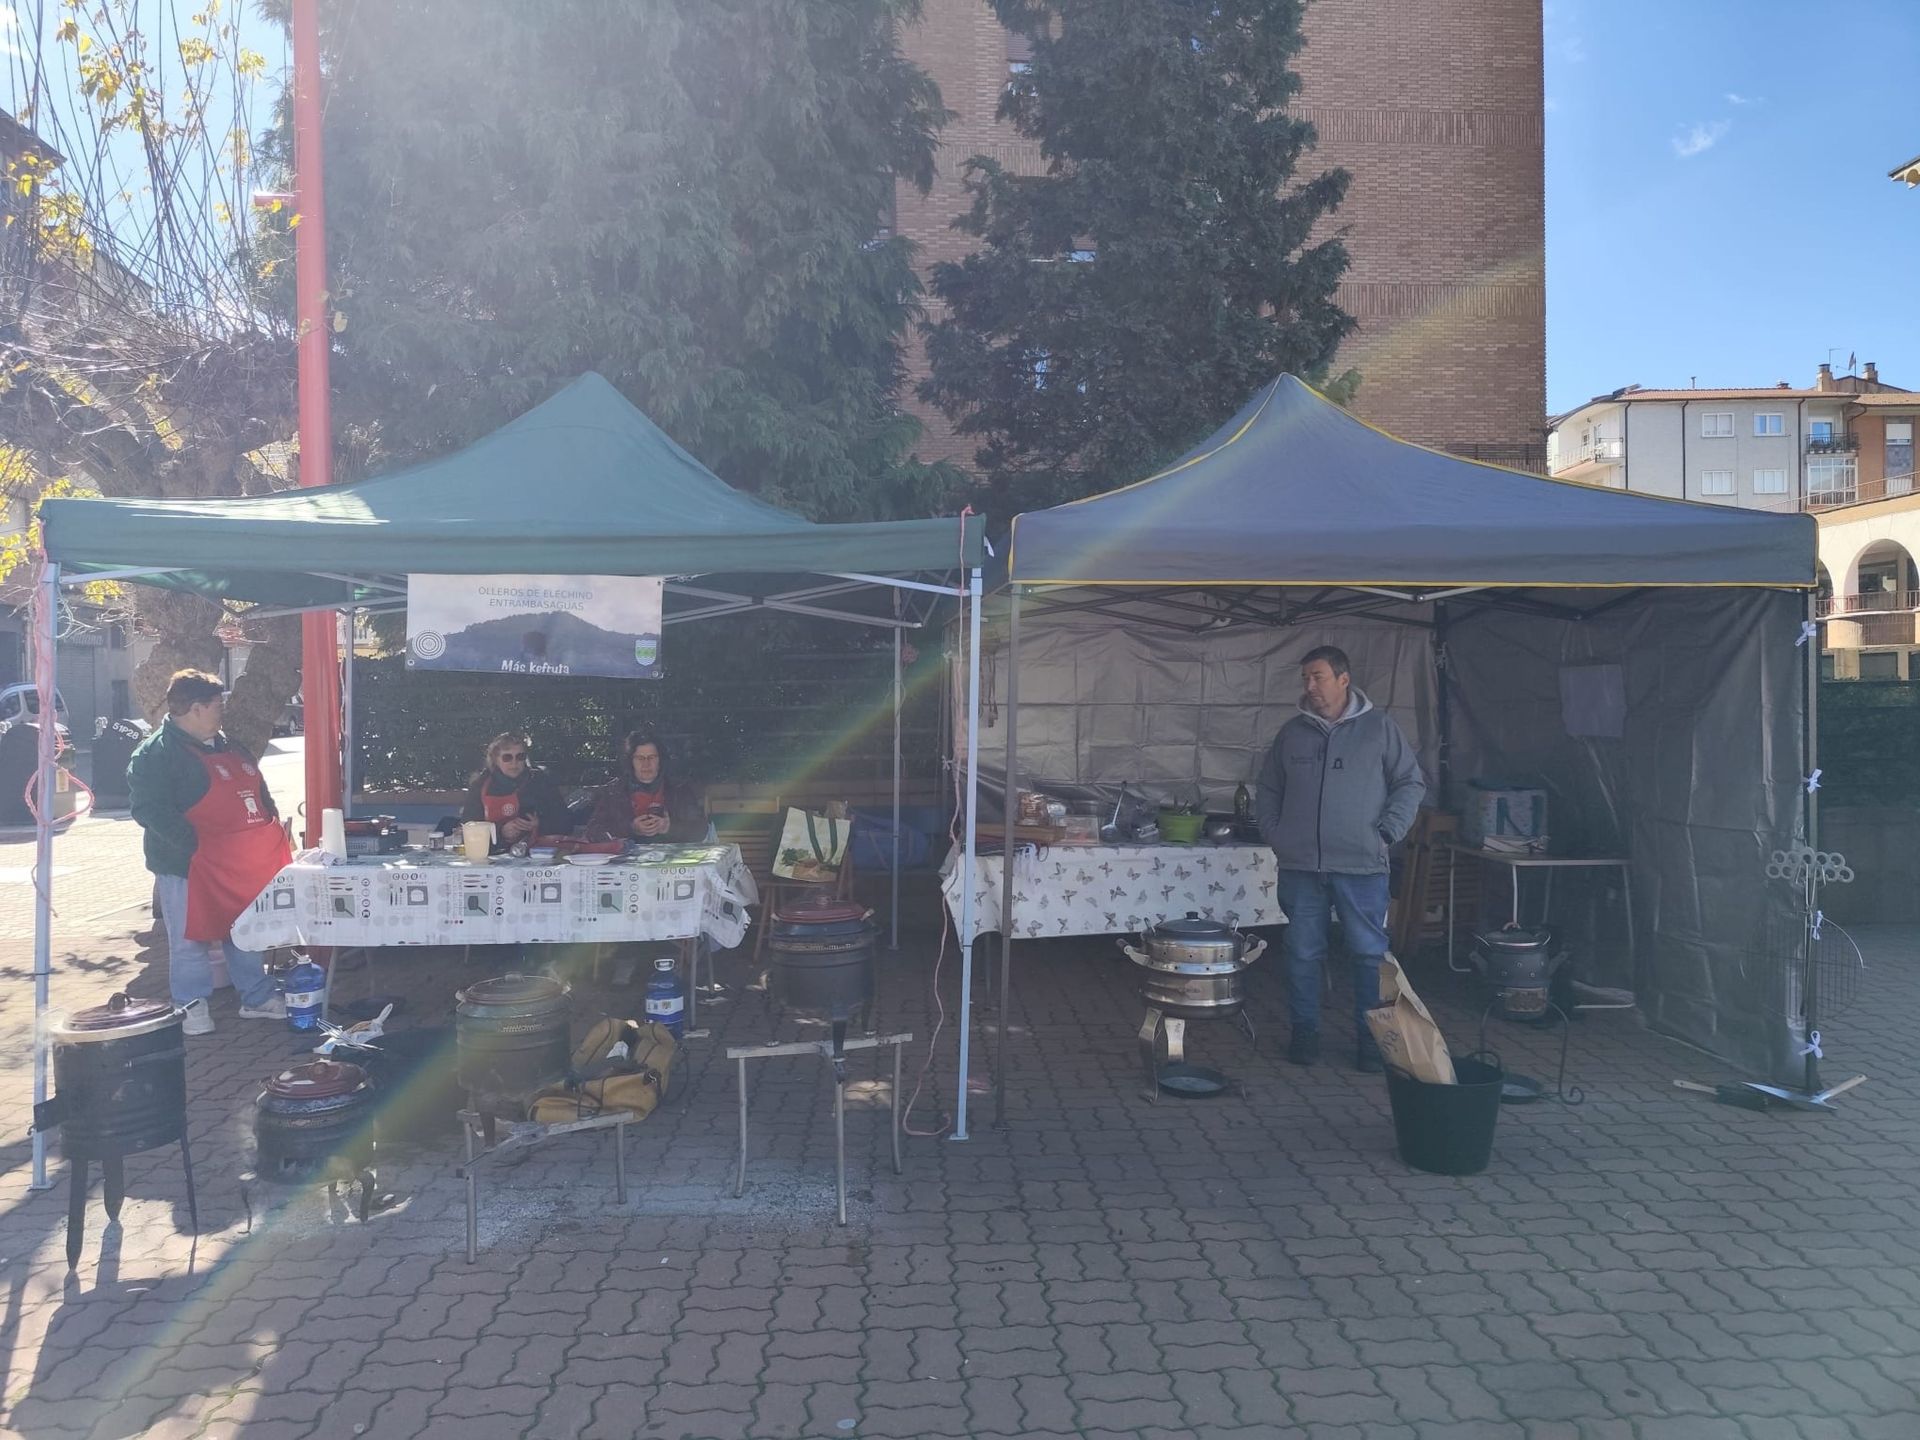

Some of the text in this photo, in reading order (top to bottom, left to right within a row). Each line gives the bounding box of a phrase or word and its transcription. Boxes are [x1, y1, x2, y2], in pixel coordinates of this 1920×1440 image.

[478, 586, 593, 600] OLLEROS DE ELECHINO
[489, 598, 585, 610] ENTRAMBASAGUAS
[501, 659, 526, 673] Más
